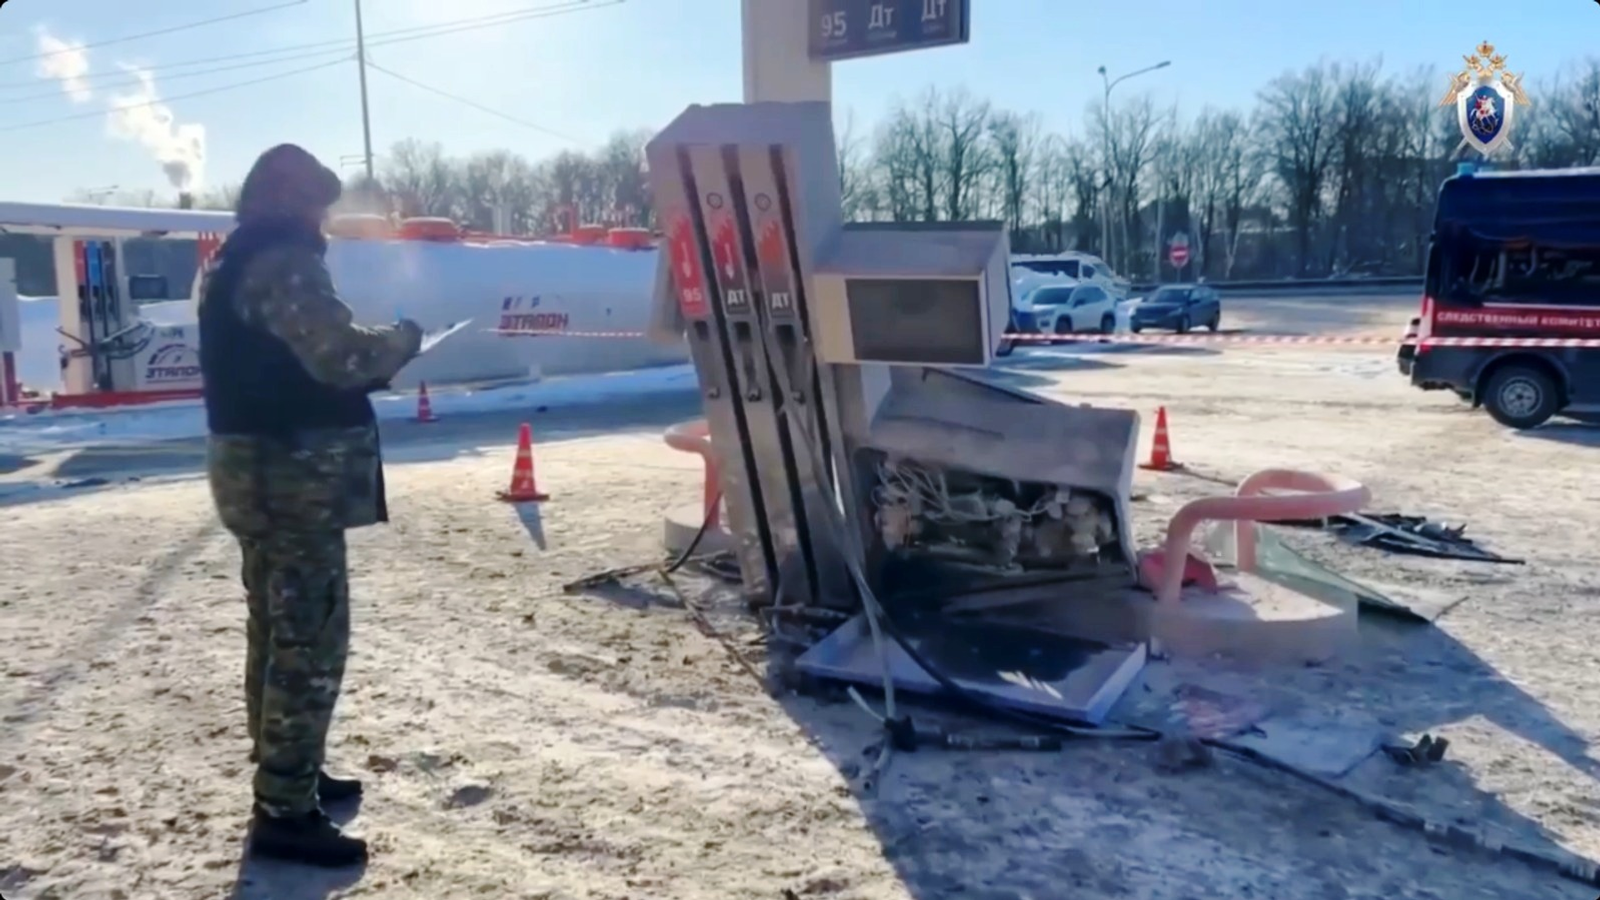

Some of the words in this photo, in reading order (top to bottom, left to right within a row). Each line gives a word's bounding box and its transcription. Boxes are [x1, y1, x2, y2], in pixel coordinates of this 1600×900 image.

[821, 11, 847, 37] 95
[683, 287, 702, 303] 95
[1437, 311, 1538, 325] СЛЕДСТВЕННЫЙ
